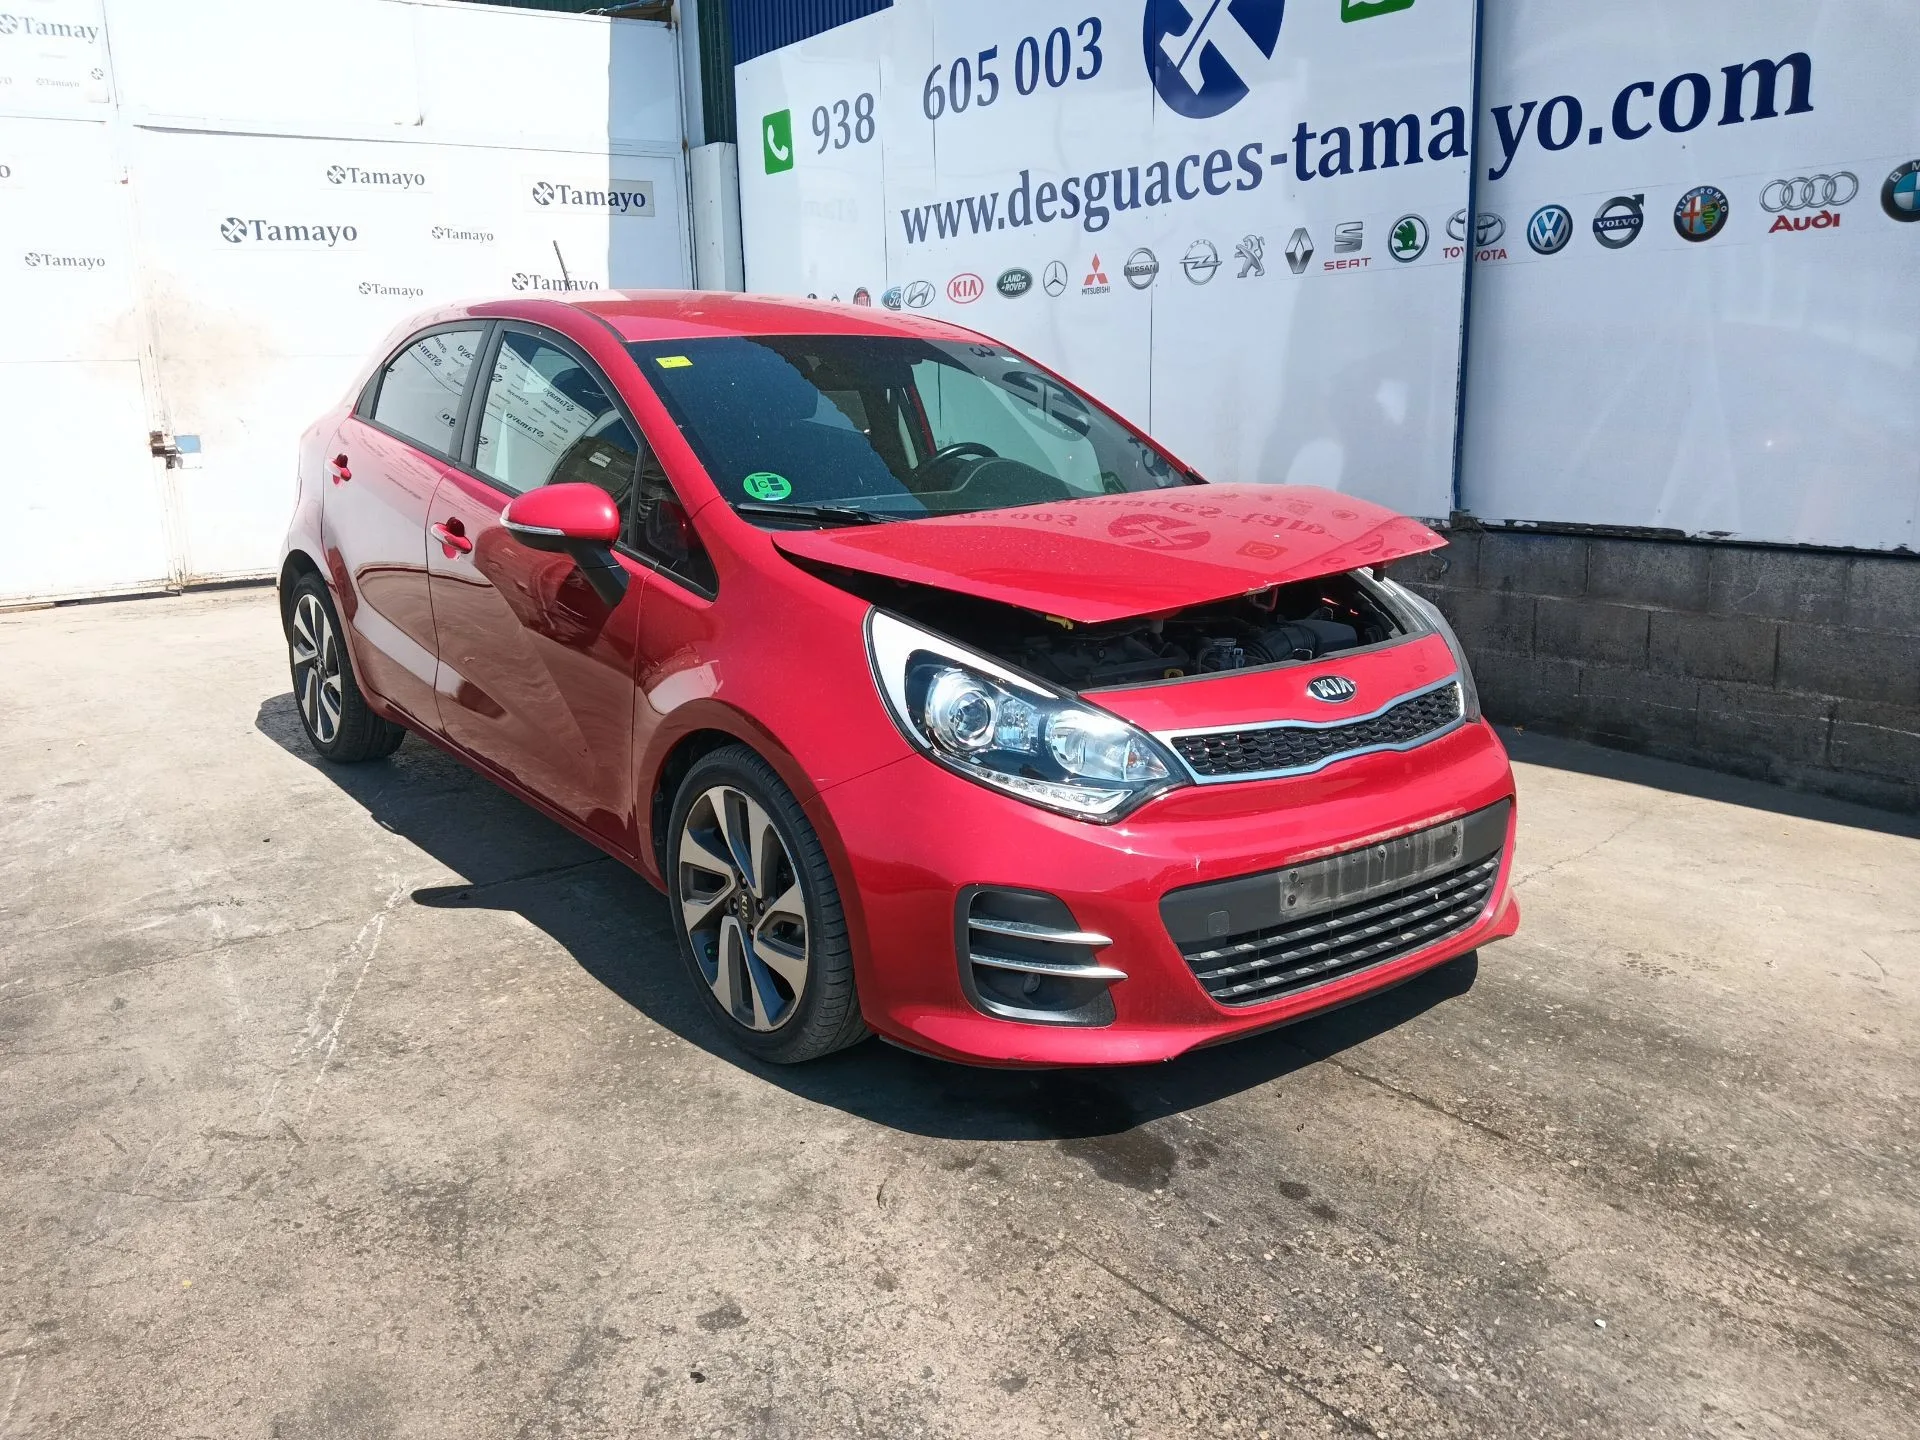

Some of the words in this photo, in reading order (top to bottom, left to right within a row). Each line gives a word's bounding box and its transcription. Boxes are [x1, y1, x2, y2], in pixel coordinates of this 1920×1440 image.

[18, 15, 99, 44] Tamay
[811, 92, 876, 154] 938
[922, 44, 1000, 120] 605
[1014, 16, 1104, 96] 003
[900, 51, 1815, 245] www.desguaces-tamayo.com
[346, 167, 426, 189] Tamayo
[1889, 161, 1920, 184] BM
[555, 184, 646, 212] Tamayo
[1700, 186, 1729, 214] ROMEO
[1596, 216, 1640, 229] VOLVO
[248, 219, 358, 247] Tamayo
[443, 228, 494, 243] Tamayo
[40, 253, 106, 271] Tamayo
[1127, 264, 1156, 274] NISSAN
[1323, 257, 1372, 271] SEAT
[953, 279, 978, 298] KIA
[1003, 273, 1022, 284] LAND
[1004, 281, 1027, 292] ROVER
[372, 283, 424, 299] Tamayo
[1081, 286, 1111, 296] MITSUBISHI
[1313, 677, 1354, 698] KIA
[741, 894, 749, 919] KIA
